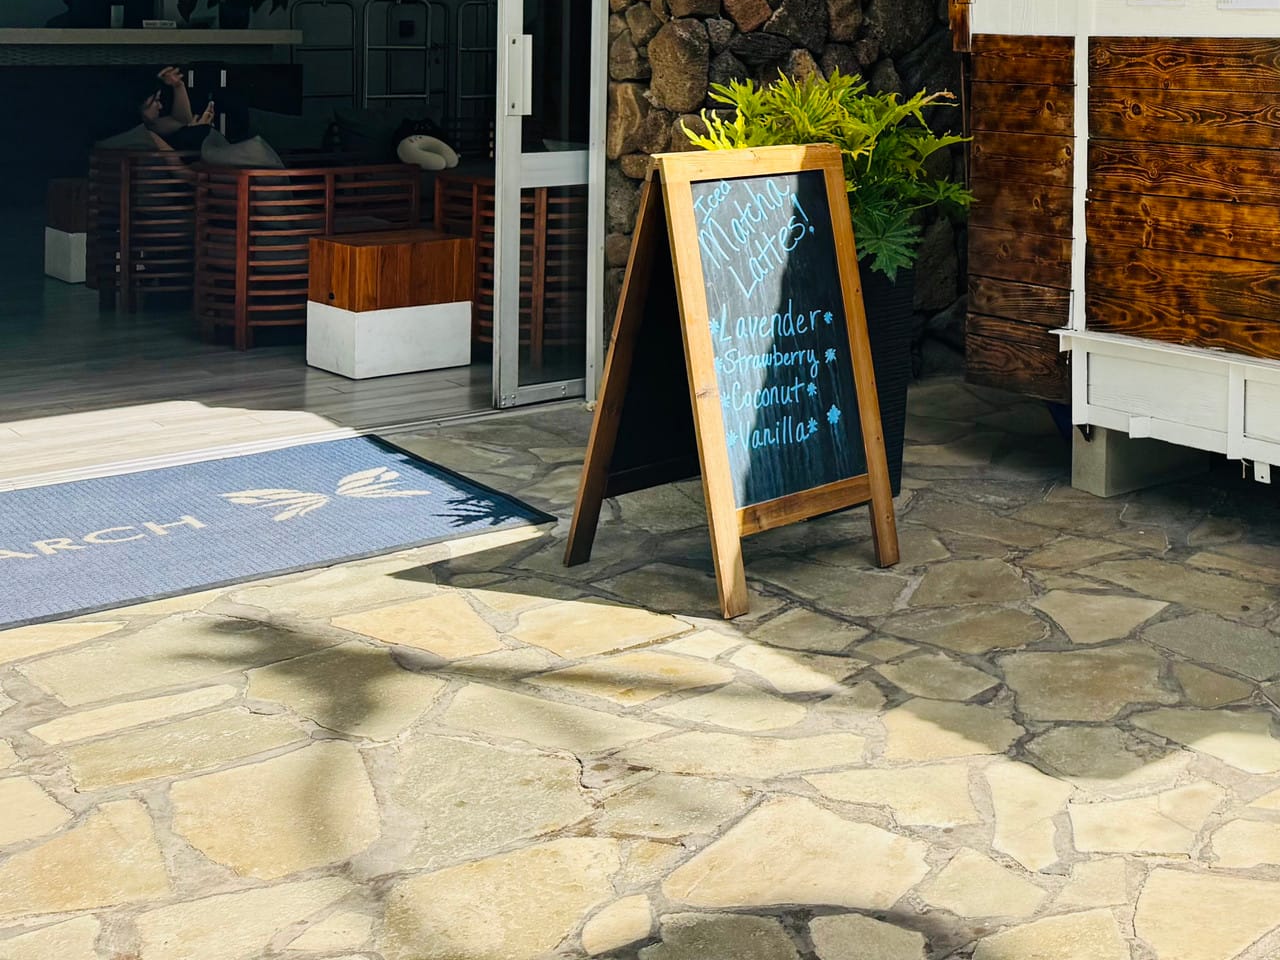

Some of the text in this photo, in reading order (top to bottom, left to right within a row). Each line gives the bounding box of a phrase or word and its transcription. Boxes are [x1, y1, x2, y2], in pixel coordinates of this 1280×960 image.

[693, 179, 732, 225] Iced
[698, 177, 791, 269] Matcha
[729, 193, 815, 298] Lattes!
[719, 299, 822, 342] Lavender
[723, 344, 820, 378] Strawberry
[731, 376, 806, 412] Coconut
[738, 417, 809, 452] Vanilla
